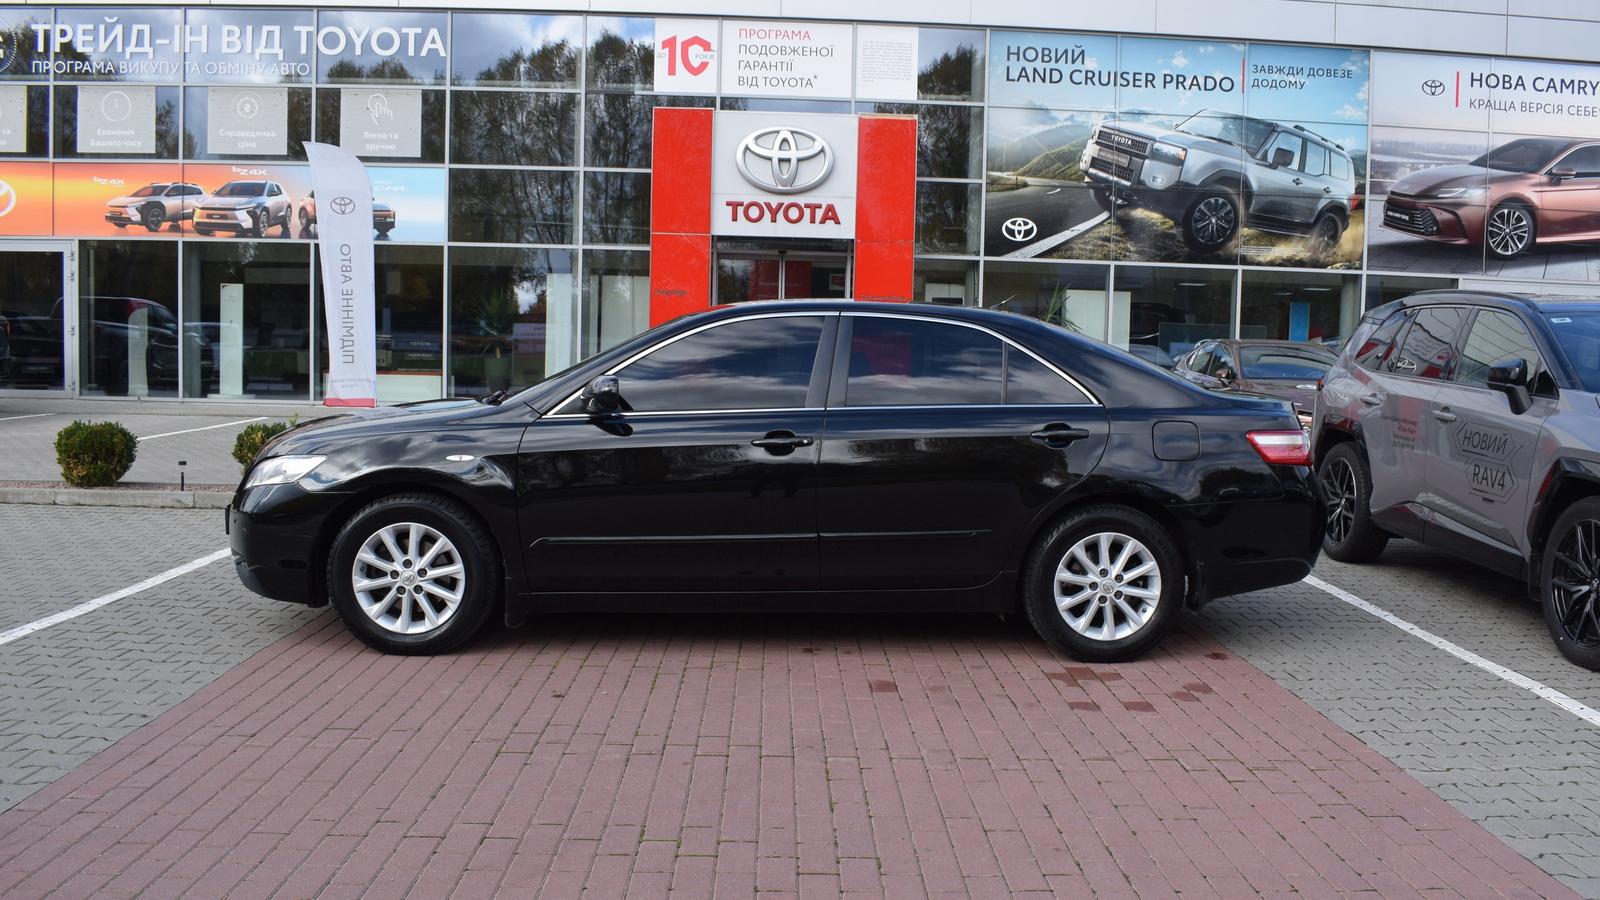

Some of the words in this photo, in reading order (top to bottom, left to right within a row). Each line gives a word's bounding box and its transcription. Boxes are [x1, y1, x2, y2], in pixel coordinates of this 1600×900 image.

[31, 16, 208, 60] ТРЕЙД-ІН
[222, 25, 284, 60] ВІД
[294, 25, 447, 57] TOYOTA
[738, 28, 811, 40] ПРОГРАМА
[738, 44, 835, 57] ПОДОВЖЕНОЇ
[1006, 44, 1085, 65] НОВИЙ
[32, 60, 115, 74] ПРОГРАМА
[119, 61, 181, 74] ВИКУПУ
[184, 62, 201, 74] ТА
[205, 62, 267, 75] ОБМІНУ
[270, 62, 310, 76] АВТО
[738, 59, 794, 71] ГАРАНТІЇ
[1252, 64, 1304, 77] ЗАВЖДИ
[1307, 67, 1353, 79] ДОВЕЗЕ
[738, 76, 759, 88] ВІД
[1006, 66, 1063, 84] LAND
[1069, 69, 1156, 89] CRUISER
[1163, 73, 1235, 92] PRADO
[1252, 78, 1306, 90] ДОДОМУ
[1470, 72, 1526, 91] НОВА
[1532, 76, 1600, 96] CAMRY
[1469, 98, 1517, 113] КРАЩА
[1520, 101, 1563, 115] ВЕРСІЯ
[97, 128, 135, 136] Економія
[218, 129, 276, 138] Справедлива
[363, 131, 388, 140] Легко
[90, 139, 121, 147] Вашого
[238, 140, 256, 149] ціна
[1111, 134, 1132, 146] TOYOTA
[365, 143, 396, 152] зручно
[726, 200, 841, 225] TOYOTA
[1462, 429, 1509, 455] НОВИЙ
[1472, 464, 1506, 491] RAV4
